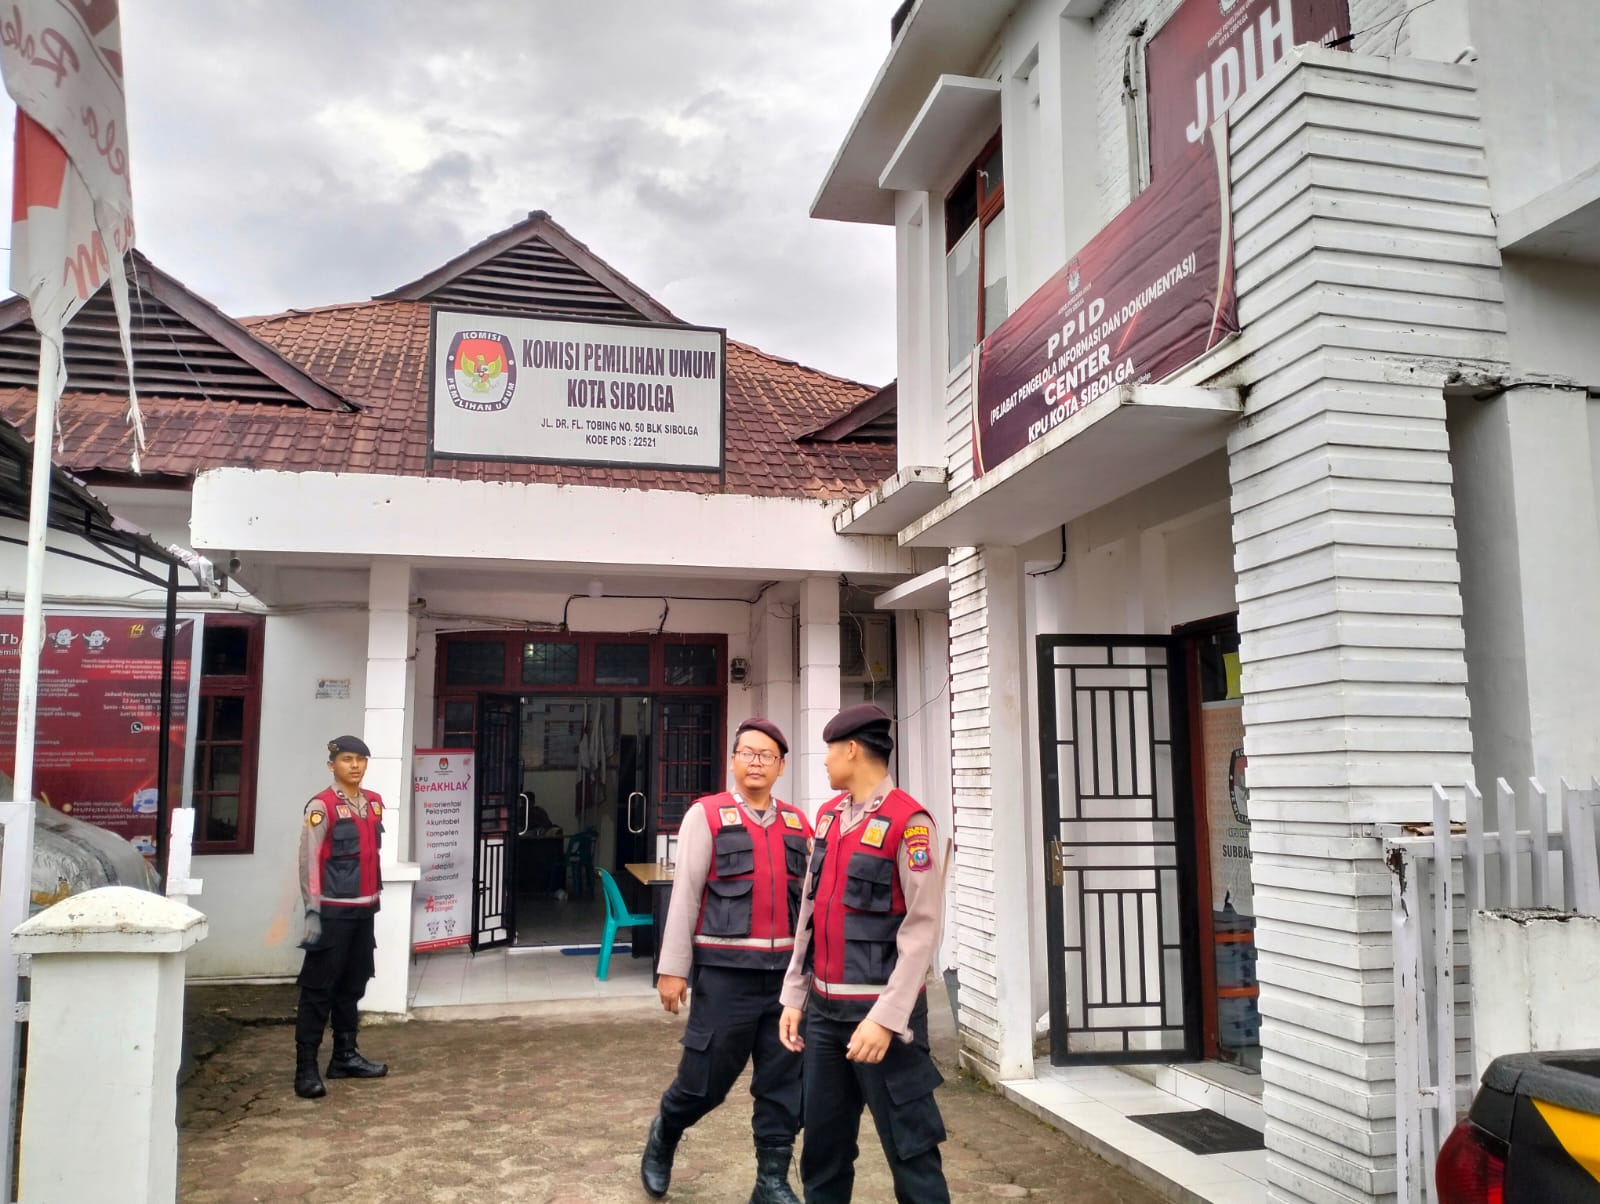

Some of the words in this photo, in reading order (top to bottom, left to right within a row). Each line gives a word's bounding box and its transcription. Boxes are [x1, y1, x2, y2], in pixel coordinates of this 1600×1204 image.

[1185, 0, 1295, 144] JDIH
[462, 331, 502, 342] KOMISI
[990, 393, 1018, 427] (PEJABAT
[1017, 366, 1058, 402] PENGELOLA
[1058, 332, 1103, 376] INFORMASI
[1102, 317, 1122, 337] DAN
[1121, 251, 1197, 324] DOKUMENTASI)
[1047, 297, 1106, 360] PPID
[522, 339, 580, 371] KOMISI
[584, 343, 665, 377] PEMILIHAN
[669, 350, 716, 380] UMUM
[1043, 343, 1111, 406] CENTER
[447, 377, 492, 411] PEMILIHAN
[494, 382, 516, 410] UMUM
[567, 379, 607, 409] KOTA
[610, 381, 675, 413] SIBOLGA
[1027, 416, 1048, 443] KPU
[1049, 400, 1079, 429] KOTA
[1080, 357, 1136, 410] SIBOLGA
[541, 418, 553, 429] JL.
[555, 419, 570, 430] DR.
[571, 420, 584, 430] FL.
[586, 420, 618, 432] TOBING
[619, 422, 633, 433] NO.
[634, 422, 646, 433] 50
[647, 423, 663, 434] BLK
[664, 424, 699, 436] SIBOLGA
[585, 434, 609, 446] KODE
[610, 435, 627, 446] POS
[633, 436, 657, 447] 22521
[415, 781, 468, 793] BerAKHLAK
[426, 830, 459, 838] Kompeten
